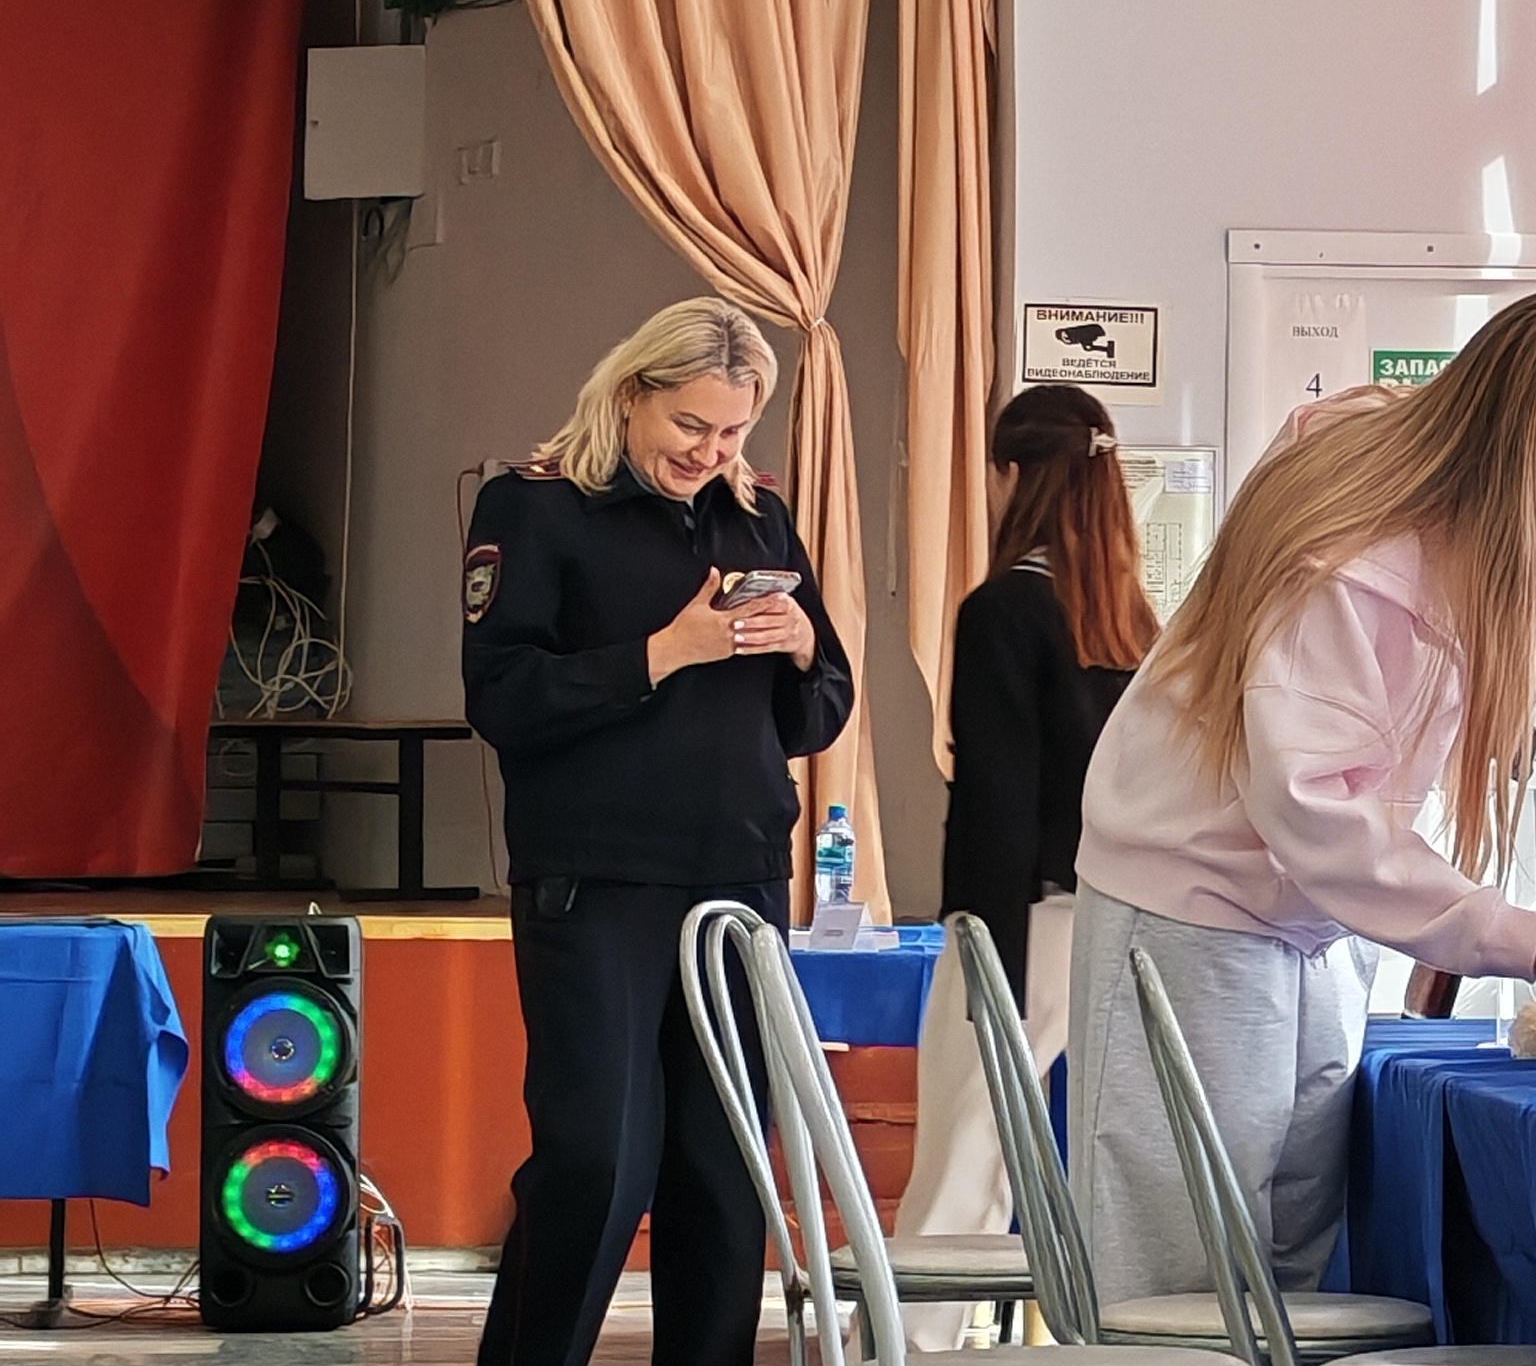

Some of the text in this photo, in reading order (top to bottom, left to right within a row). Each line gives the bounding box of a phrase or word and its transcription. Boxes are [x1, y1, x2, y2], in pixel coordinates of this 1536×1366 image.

[1036, 309, 1145, 324] ВНИМАНИЕ!!!
[1292, 325, 1340, 338] ВЫХОД
[1027, 368, 1150, 381] ВИДЕОНАБЛЮДЕНИЕ
[1305, 372, 1323, 398] 4
